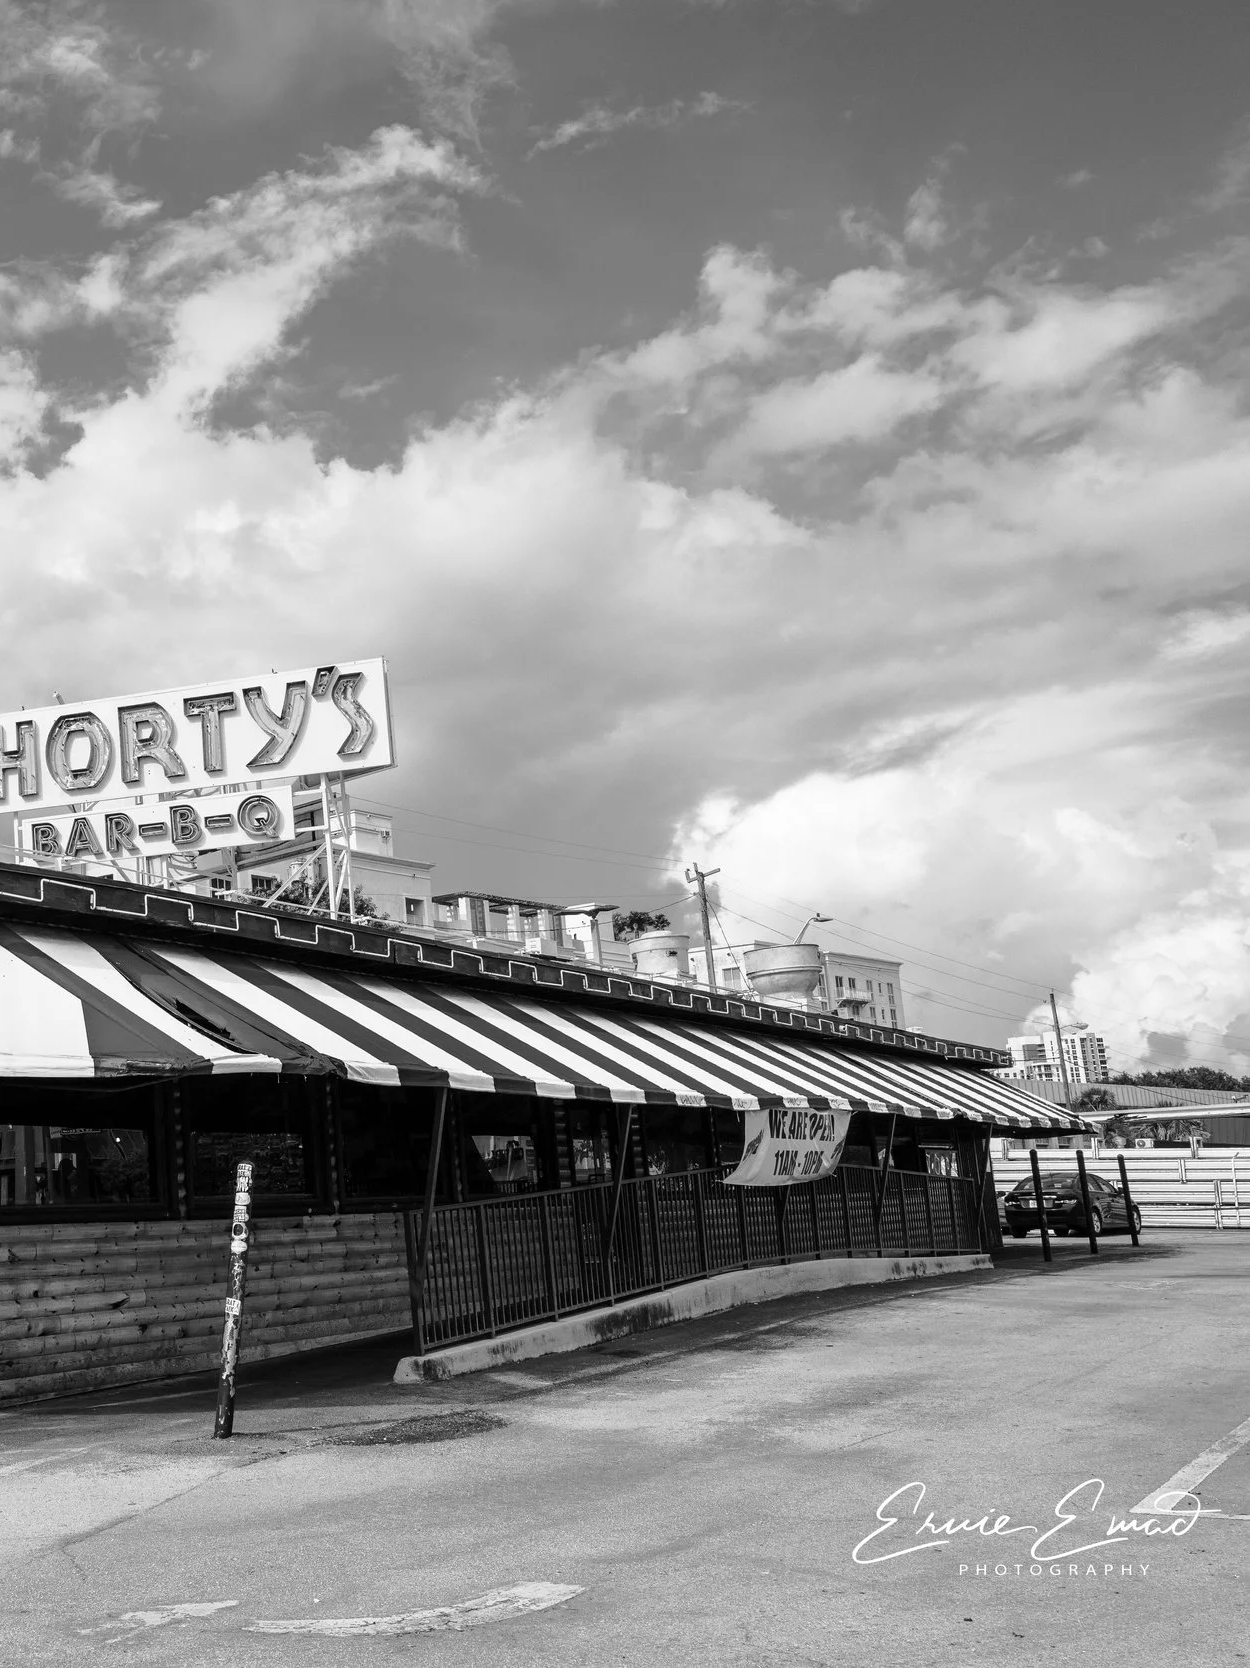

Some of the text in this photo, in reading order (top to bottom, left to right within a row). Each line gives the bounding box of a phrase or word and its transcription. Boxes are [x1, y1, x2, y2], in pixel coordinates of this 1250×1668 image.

[31, 794, 281, 857] BAR-B-Q
[769, 1109, 788, 1139] WE
[788, 1111, 808, 1140] ARE
[773, 1149, 798, 1176] 11AM
[801, 1150, 825, 1176] 10PM
